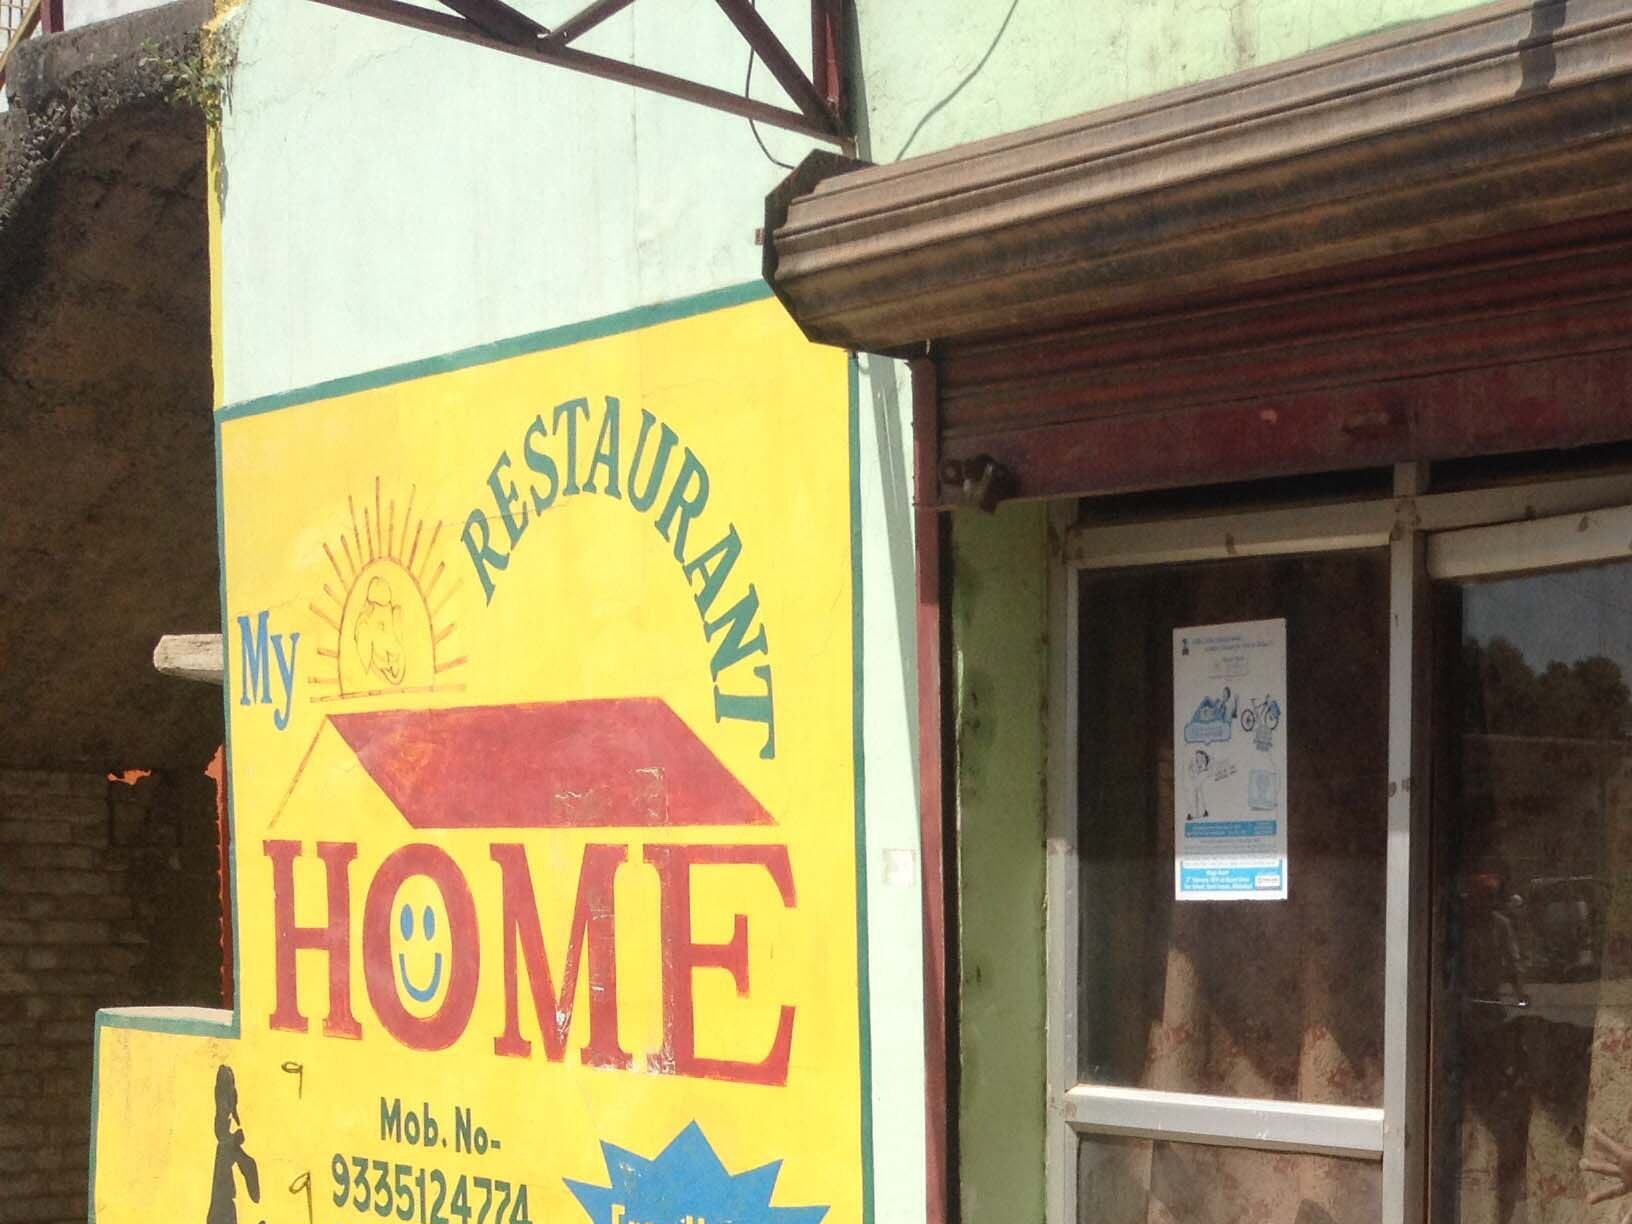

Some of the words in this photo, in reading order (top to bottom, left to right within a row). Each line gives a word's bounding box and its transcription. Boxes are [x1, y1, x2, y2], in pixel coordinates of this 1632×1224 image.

[460, 396, 775, 759] RESTAURANT
[237, 611, 299, 730] My
[263, 839, 797, 1086] HOME
[381, 1097, 447, 1148] Mob.
